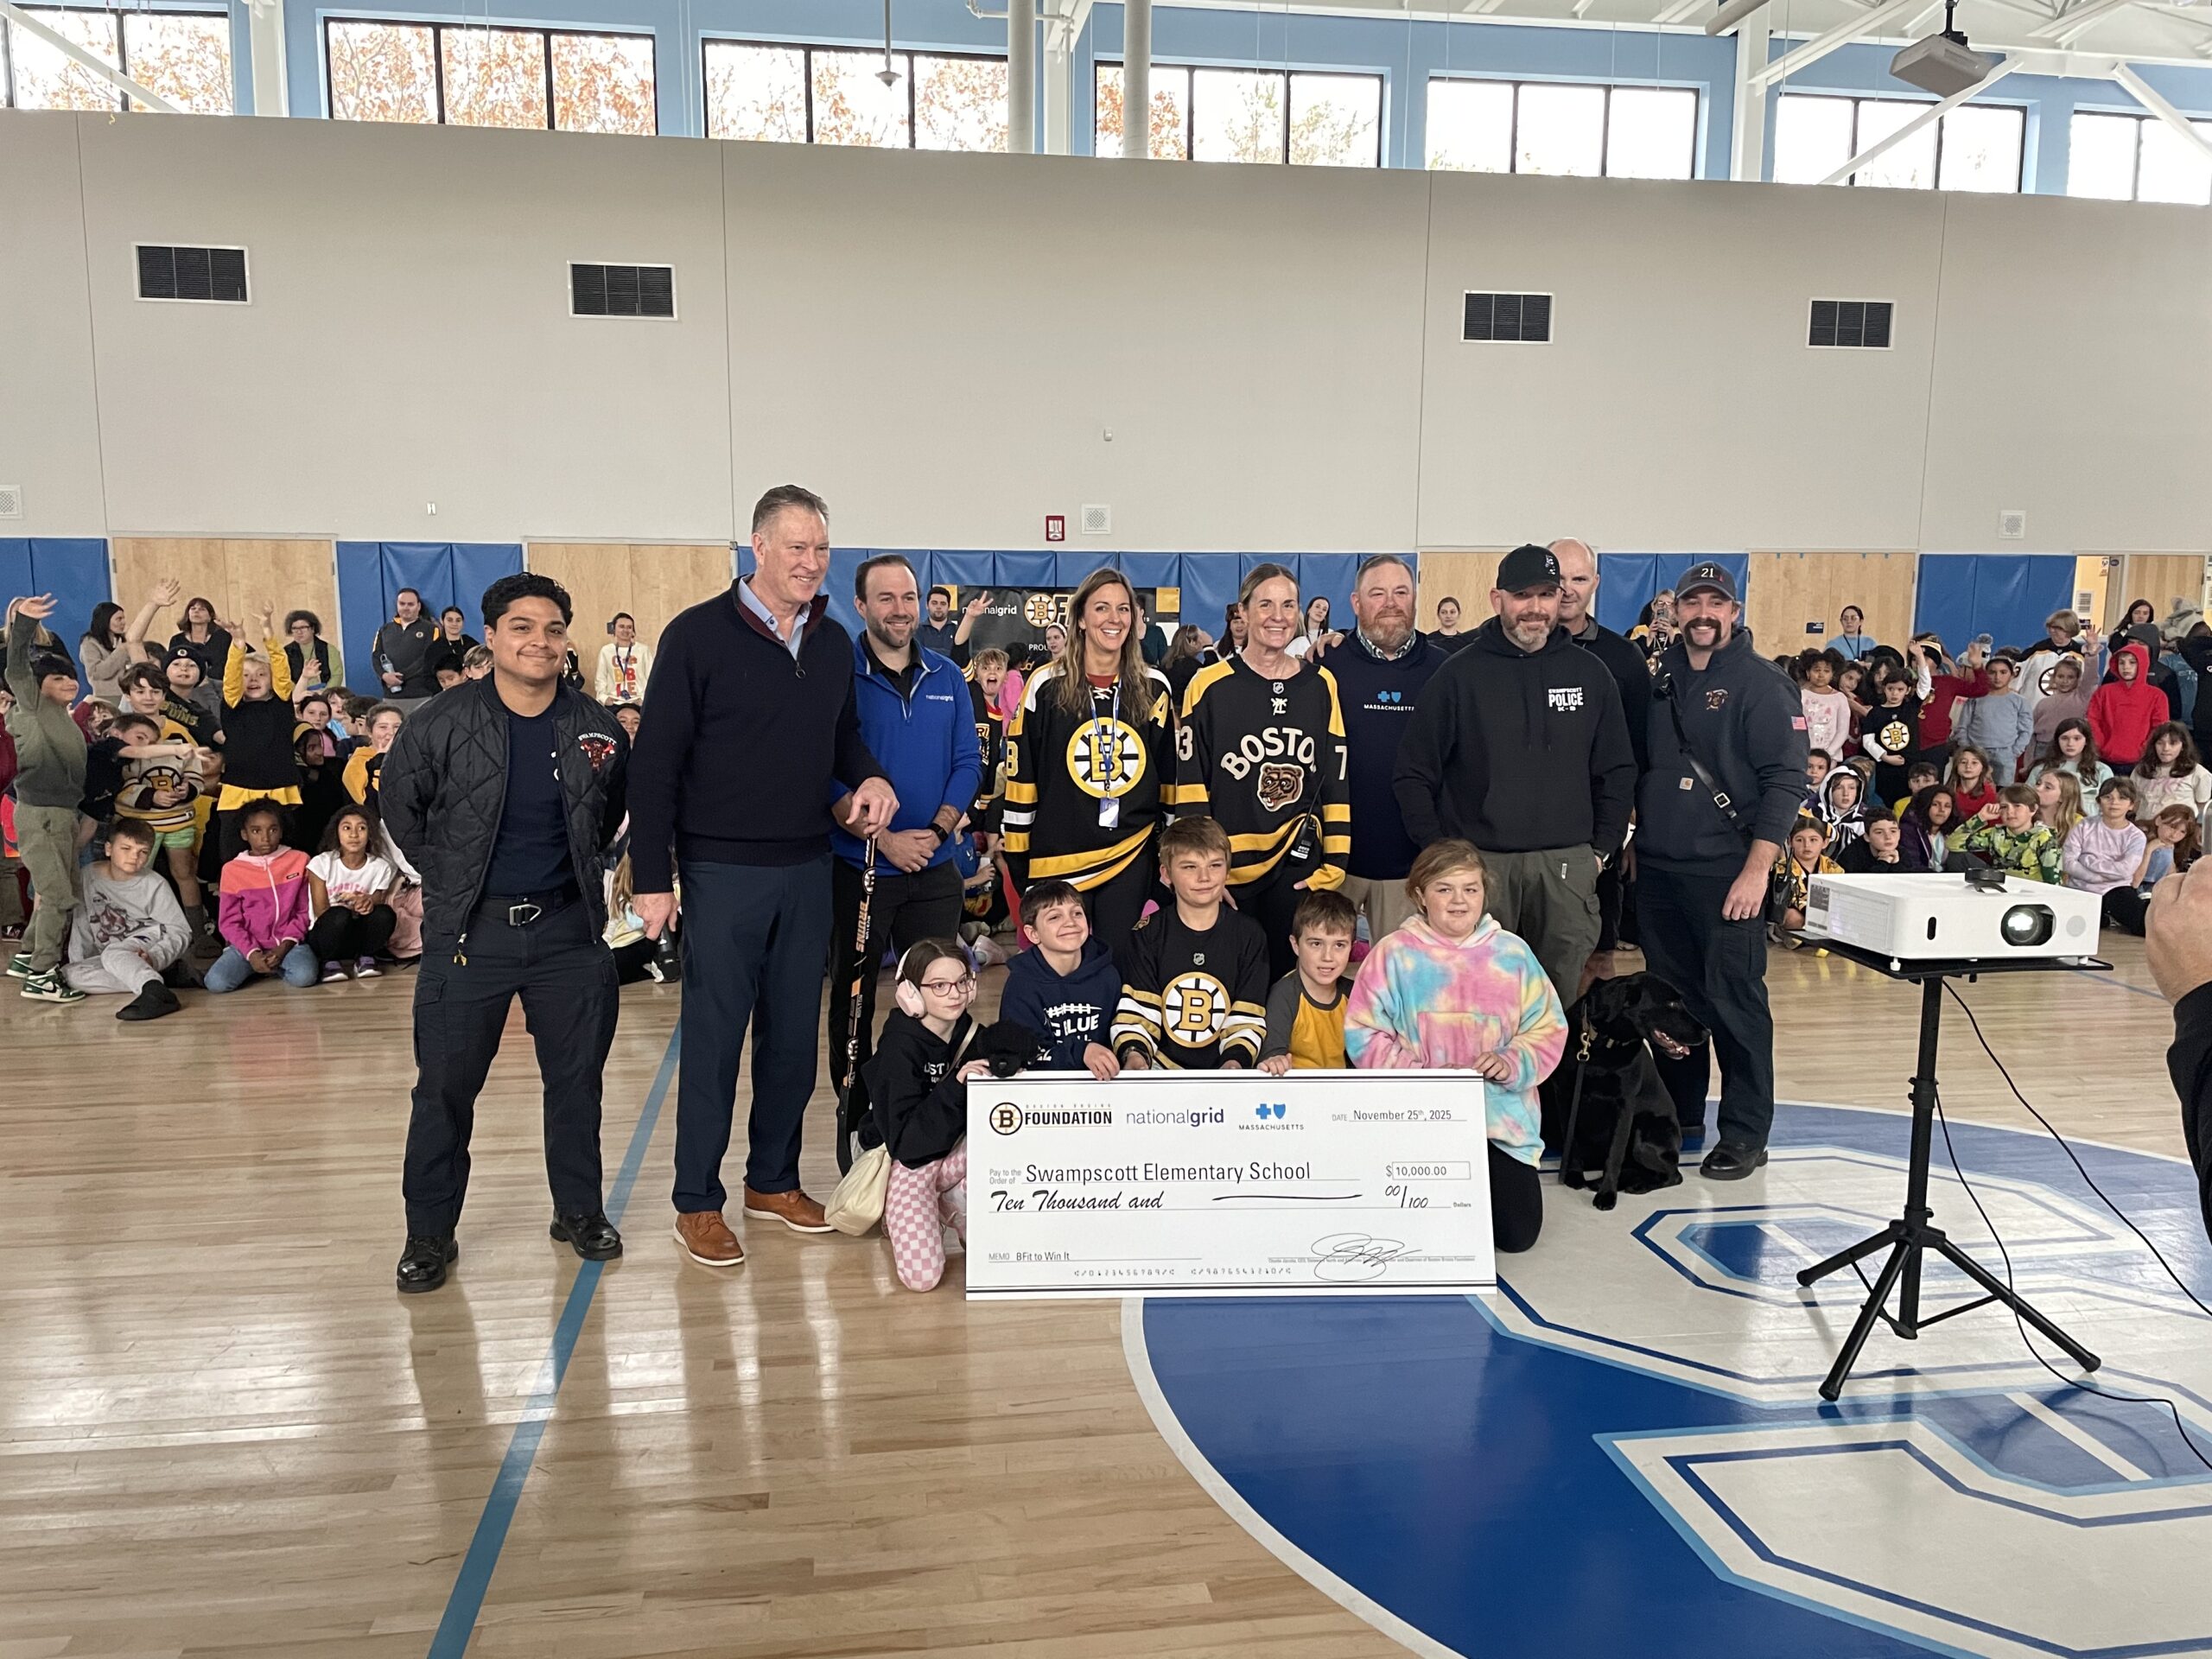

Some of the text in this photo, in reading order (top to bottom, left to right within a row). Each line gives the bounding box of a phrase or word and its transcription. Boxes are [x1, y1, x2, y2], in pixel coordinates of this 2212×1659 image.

[1700, 568, 1714, 578] 21
[962, 605, 1018, 617] nnalgrid
[1548, 692, 1584, 708] POLICE
[1148, 690, 1169, 729] A
[1220, 727, 1317, 781] BOSTO
[1335, 745, 1348, 780] 7
[855, 900, 868, 952] BRUINS
[1025, 1111, 1112, 1125] FOUNDATION
[1126, 1107, 1224, 1127] nationalgrid
[1353, 1109, 1404, 1120] November
[1429, 1109, 1452, 1120] 2025
[989, 1168, 1001, 1177] Pay
[1027, 1161, 1311, 1185] Swampscott Elementary School
[1385, 1165, 1447, 1177] $ 10,000.00
[990, 1189, 1165, 1211] Ten Thousand and
[1034, 1253, 1043, 1262] to
[1044, 1252, 1063, 1262] Win
[1064, 1252, 1070, 1261] It
